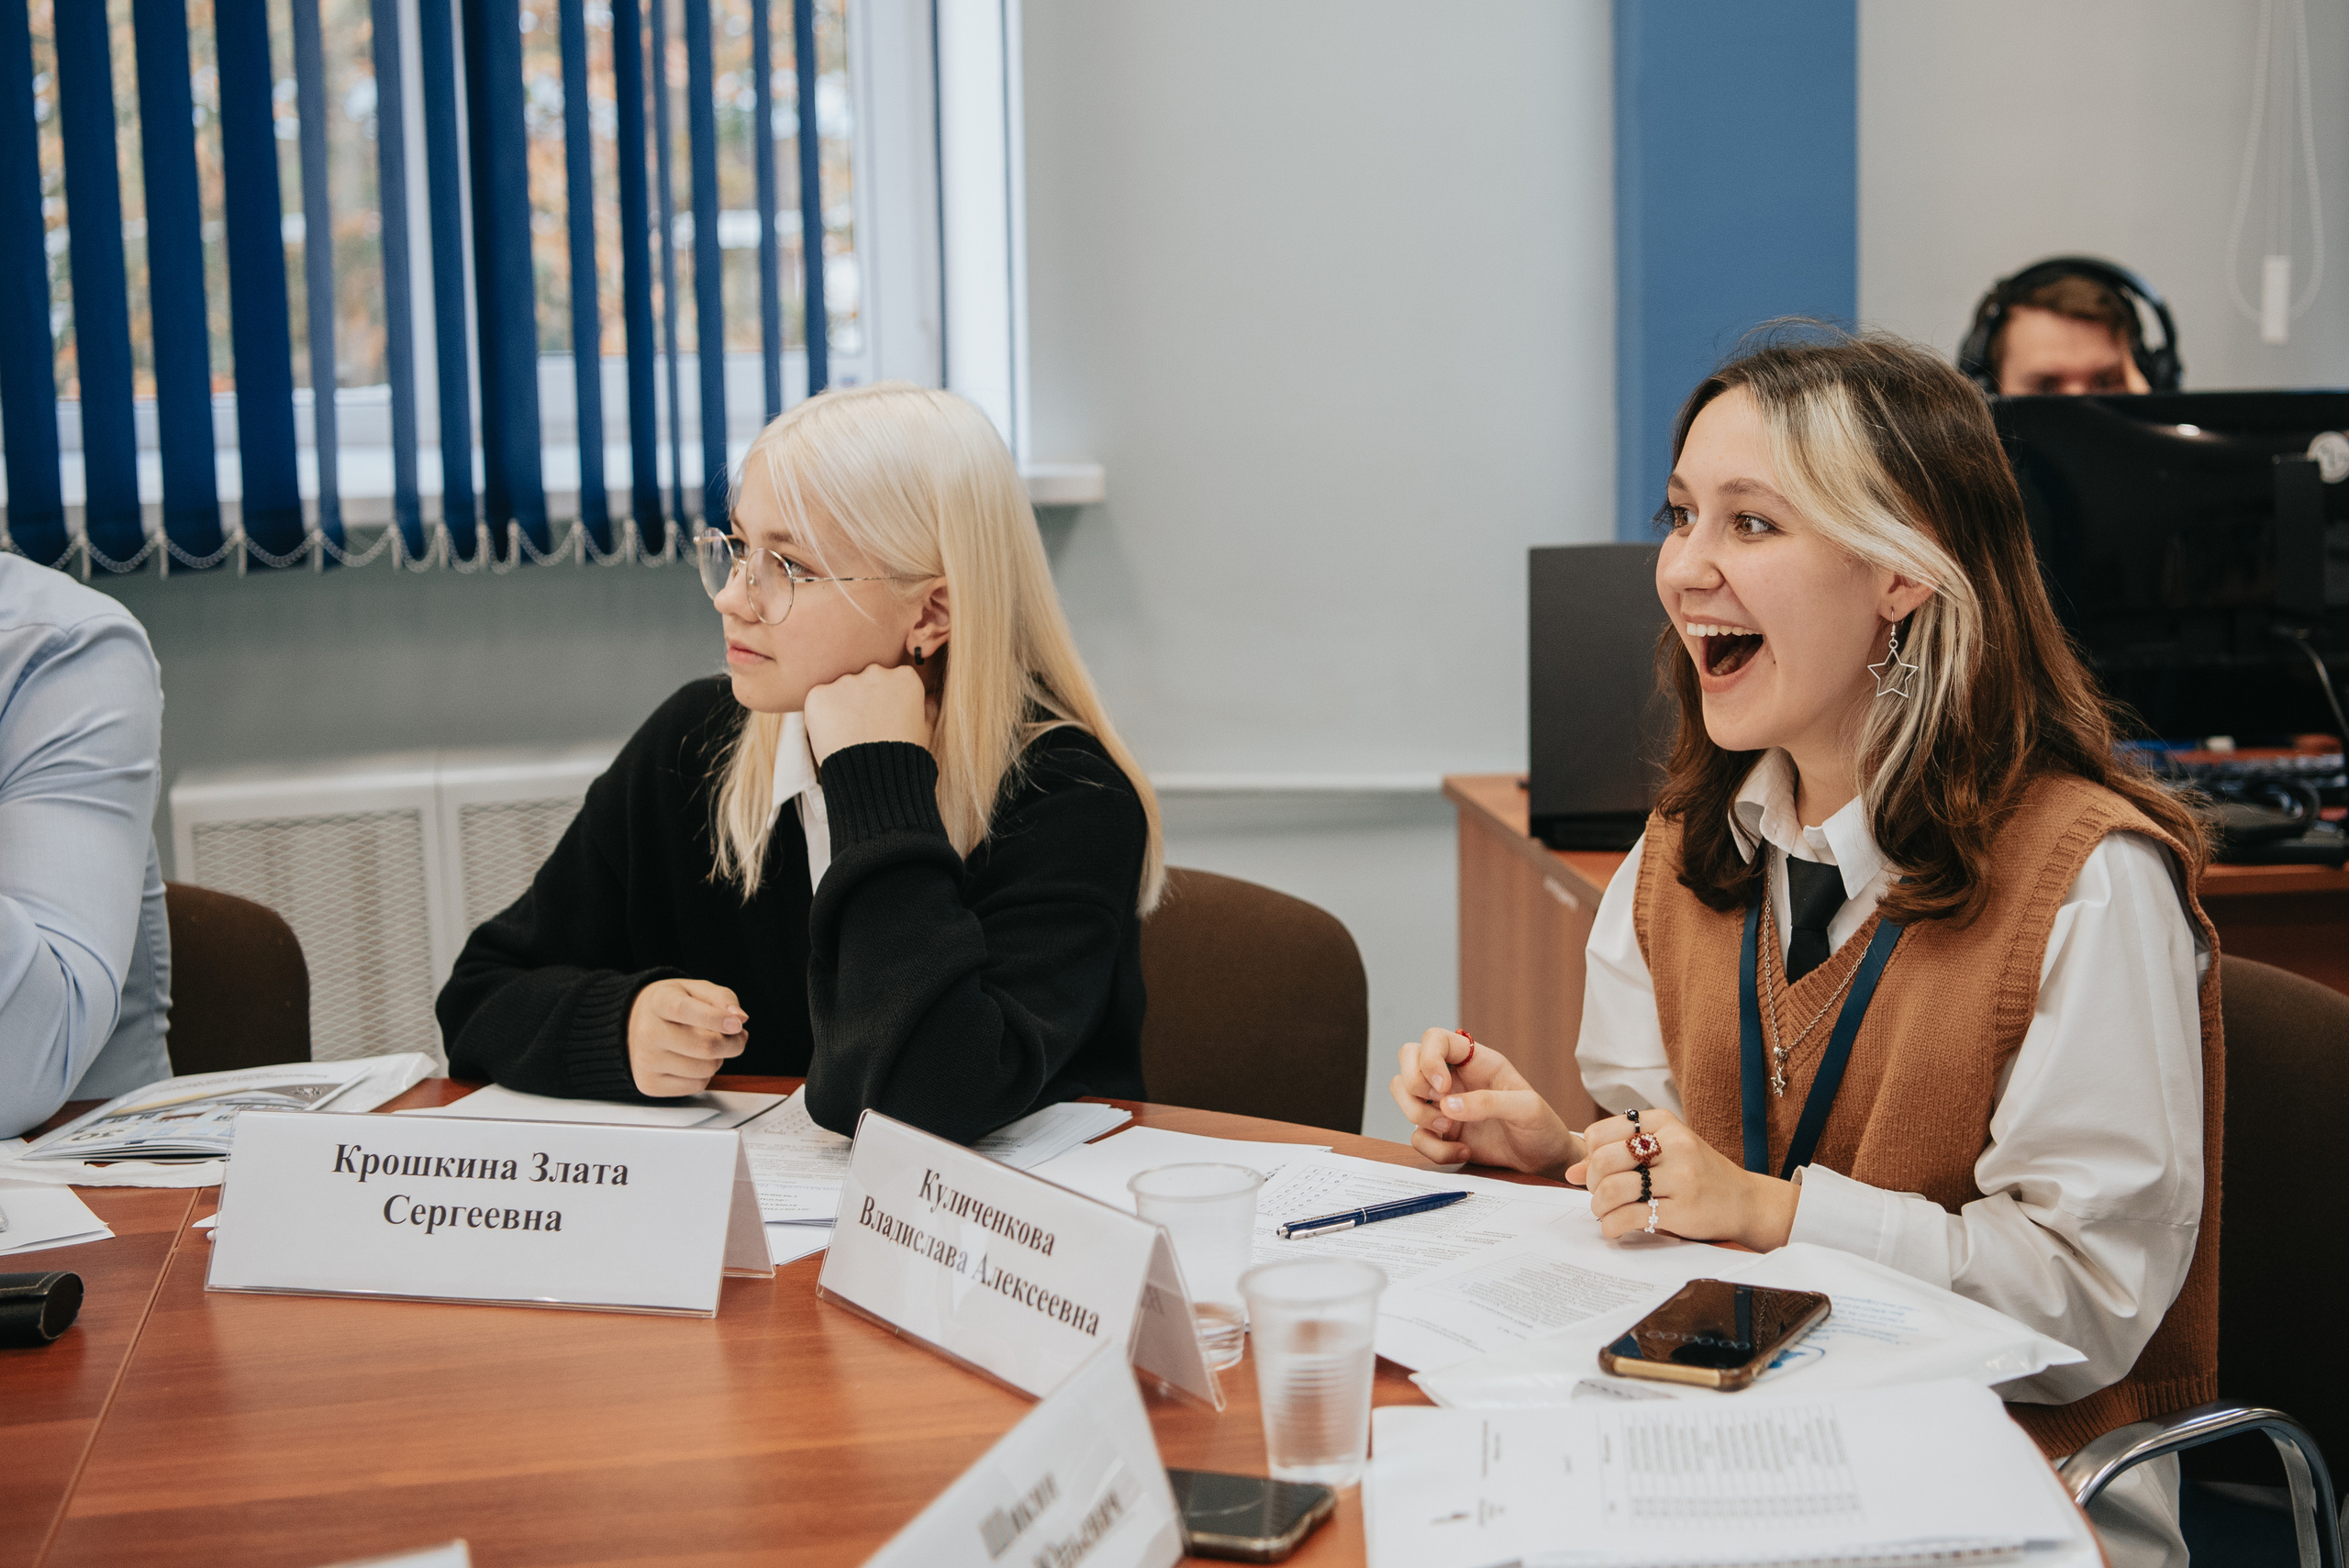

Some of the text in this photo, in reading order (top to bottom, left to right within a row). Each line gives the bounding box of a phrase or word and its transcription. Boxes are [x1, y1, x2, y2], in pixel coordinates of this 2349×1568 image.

[331, 1144, 629, 1186] Крошкина Злата
[383, 1194, 562, 1235] Сергеевна
[918, 1168, 1056, 1257] Куличенкова
[858, 1195, 969, 1274] Владислава
[971, 1252, 1100, 1338] Алексеевна
